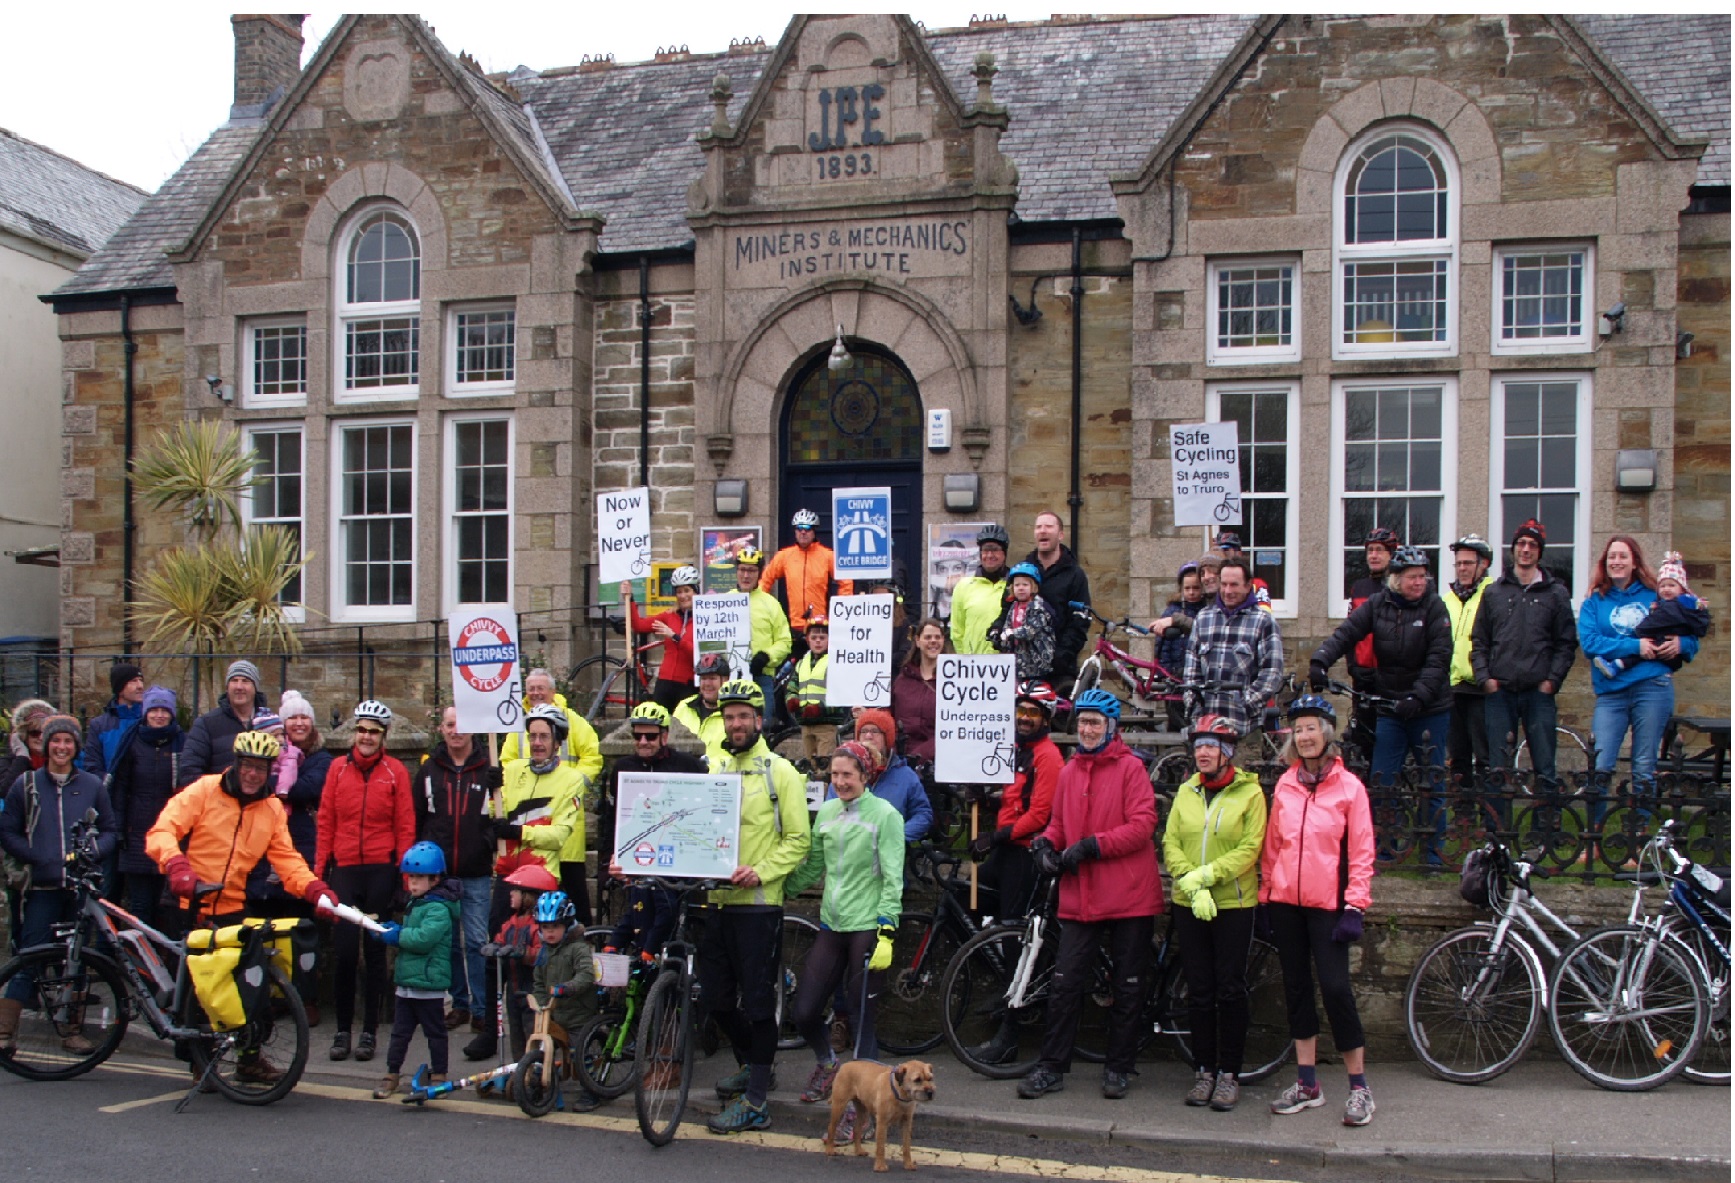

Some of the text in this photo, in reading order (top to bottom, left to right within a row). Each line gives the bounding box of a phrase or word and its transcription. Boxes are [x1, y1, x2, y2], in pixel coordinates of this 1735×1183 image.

[736, 232, 821, 271] MINERS
[828, 229, 841, 247] &
[780, 252, 911, 280] INSTITUTE
[1174, 430, 1210, 446] Safe
[1174, 447, 1236, 466] Cycling
[1176, 470, 1230, 485] St Agnes
[1177, 484, 1225, 495] to Truro
[606, 496, 642, 512] Now
[847, 499, 874, 510] CHIVVY
[616, 517, 633, 530] or
[601, 534, 649, 553] Never
[838, 555, 888, 566] CYCLE BRIDGE
[695, 595, 748, 610] Respond
[696, 611, 739, 627] by 12th
[833, 601, 892, 621] Cycling
[463, 619, 503, 638] CHIVVY
[696, 626, 736, 640] March!
[850, 625, 872, 641] for
[454, 645, 515, 663] UNDERPASS
[835, 648, 885, 664] Health
[942, 659, 1011, 682] Chivvy
[470, 675, 503, 690] CYCLE
[941, 681, 998, 706] Cycle
[940, 708, 1011, 726] Underpass
[940, 727, 1006, 743] or Bridge!
